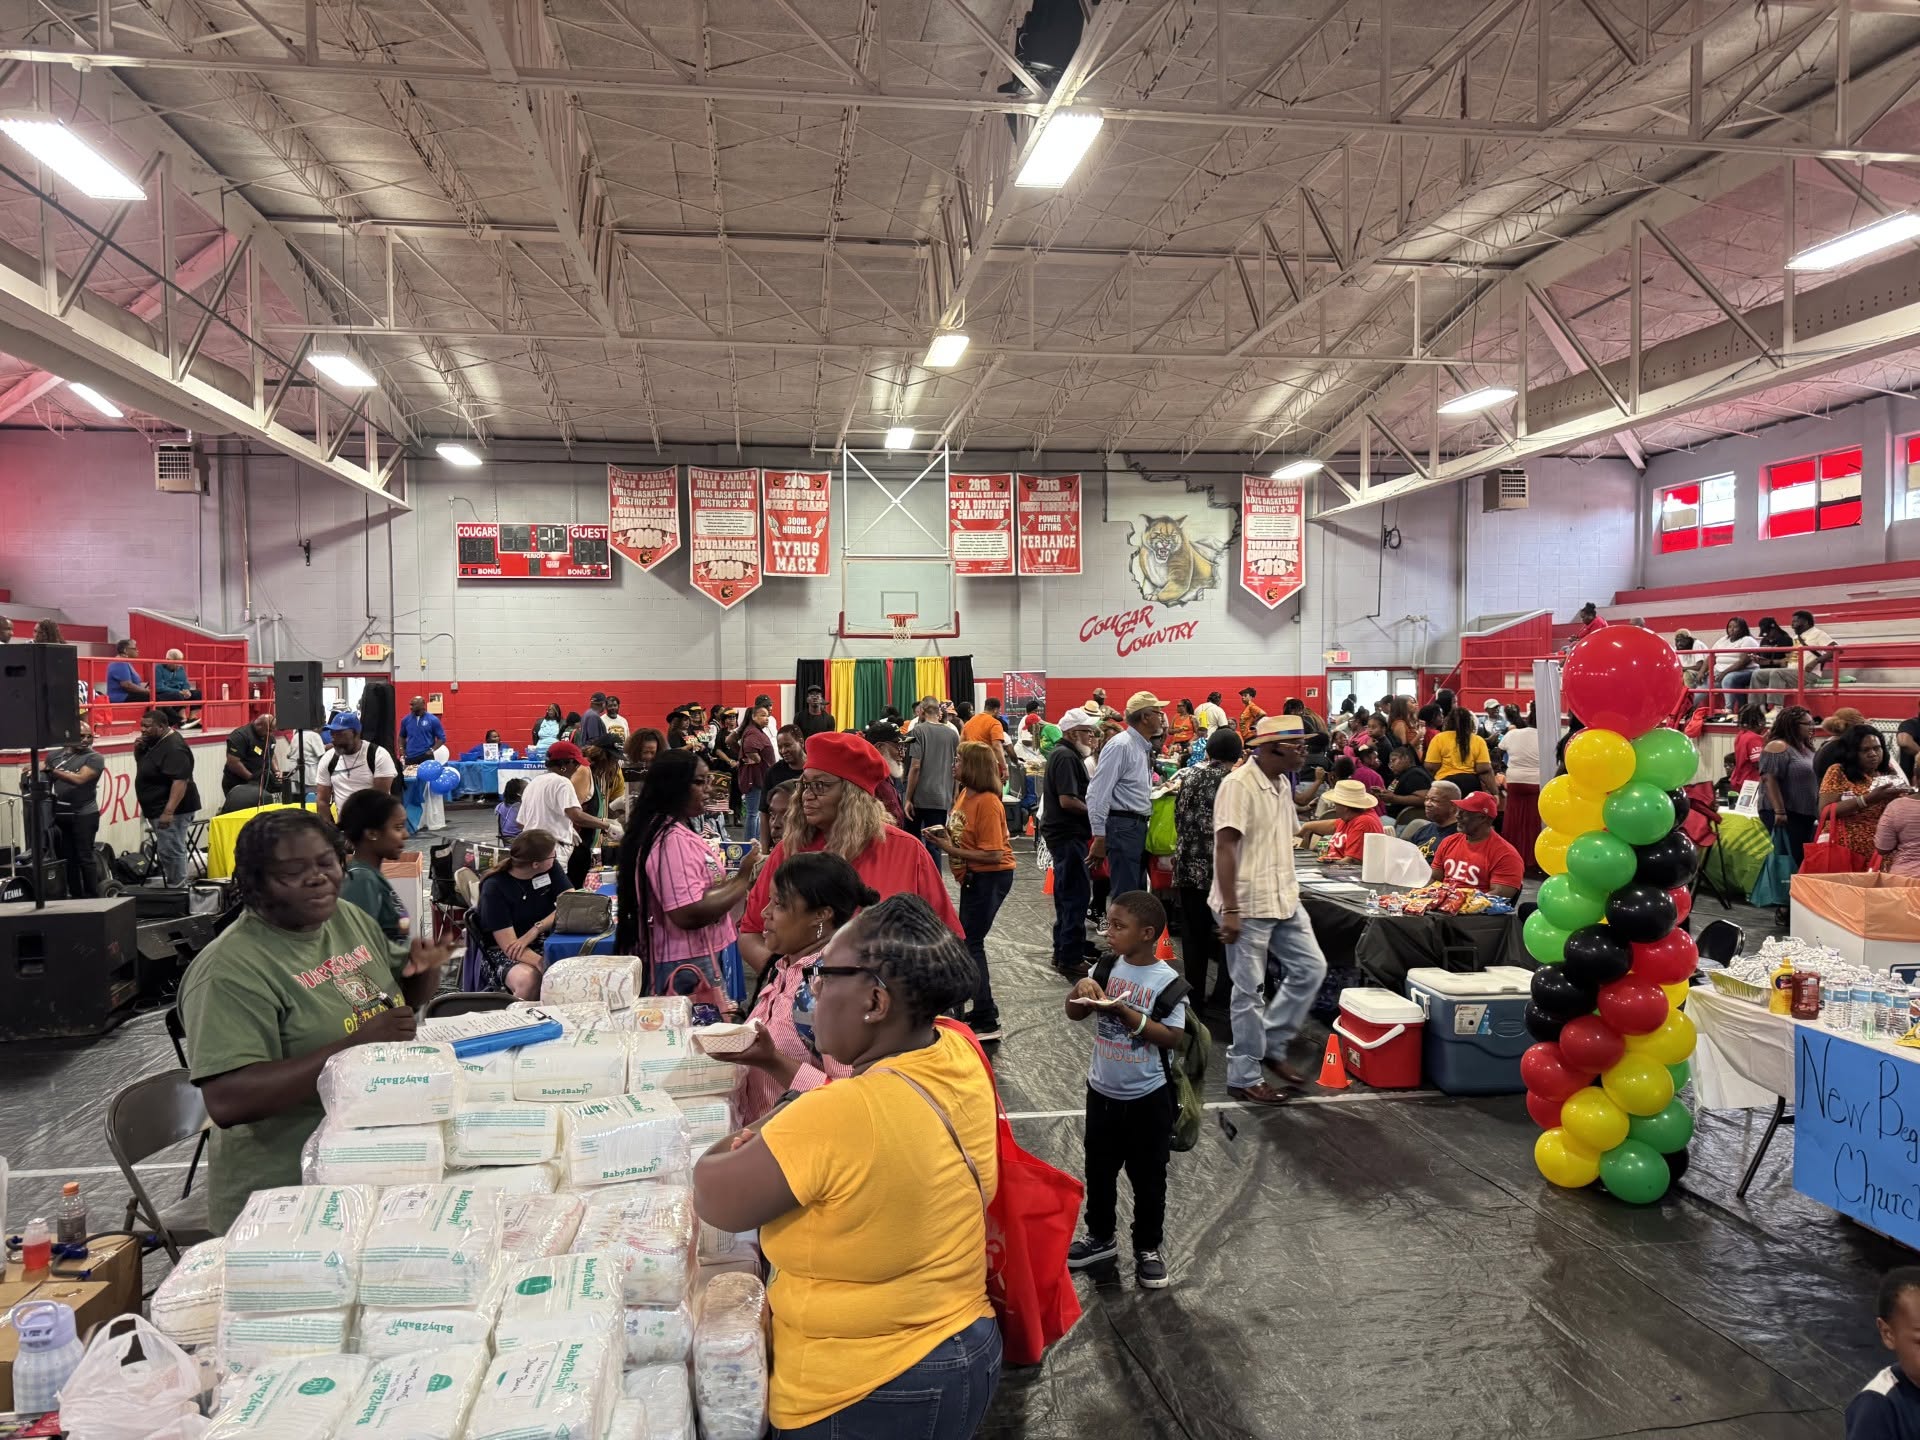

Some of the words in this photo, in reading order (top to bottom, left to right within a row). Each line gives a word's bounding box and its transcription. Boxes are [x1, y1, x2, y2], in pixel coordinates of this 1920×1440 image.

[697, 480, 717, 489] HIGH
[720, 481, 751, 489] SCHOOL
[694, 490, 713, 498] GIRLS
[714, 491, 755, 499] BASKETBALL
[768, 489, 826, 500] MISSISSIPPI
[619, 496, 651, 505] DISTRICT
[652, 497, 668, 506] 3-3A
[700, 499, 732, 508] DISTRICT
[732, 500, 749, 508] 3-3A
[797, 500, 828, 512] CHAMP
[951, 499, 970, 509] 3-3A
[973, 499, 1010, 510] DISTRICT
[612, 507, 675, 518] TOURNAMENT
[957, 510, 1004, 520] CHAMPIONS
[458, 526, 498, 537] COUGARS
[571, 528, 608, 538] GUEST
[782, 526, 812, 535] HURDLES
[694, 540, 757, 550] TOURNAMENT
[1022, 535, 1076, 548] TERRANCE
[772, 541, 819, 557] TYRUS
[1038, 550, 1060, 563] JOY
[775, 557, 816, 573] MACK
[1080, 605, 1155, 642] COUGAR
[1117, 621, 1199, 657] COUNTRY
[366, 645, 379, 655] EXIT
[1327, 1053, 1336, 1064] 21
[1801, 1035, 1870, 1134] New
